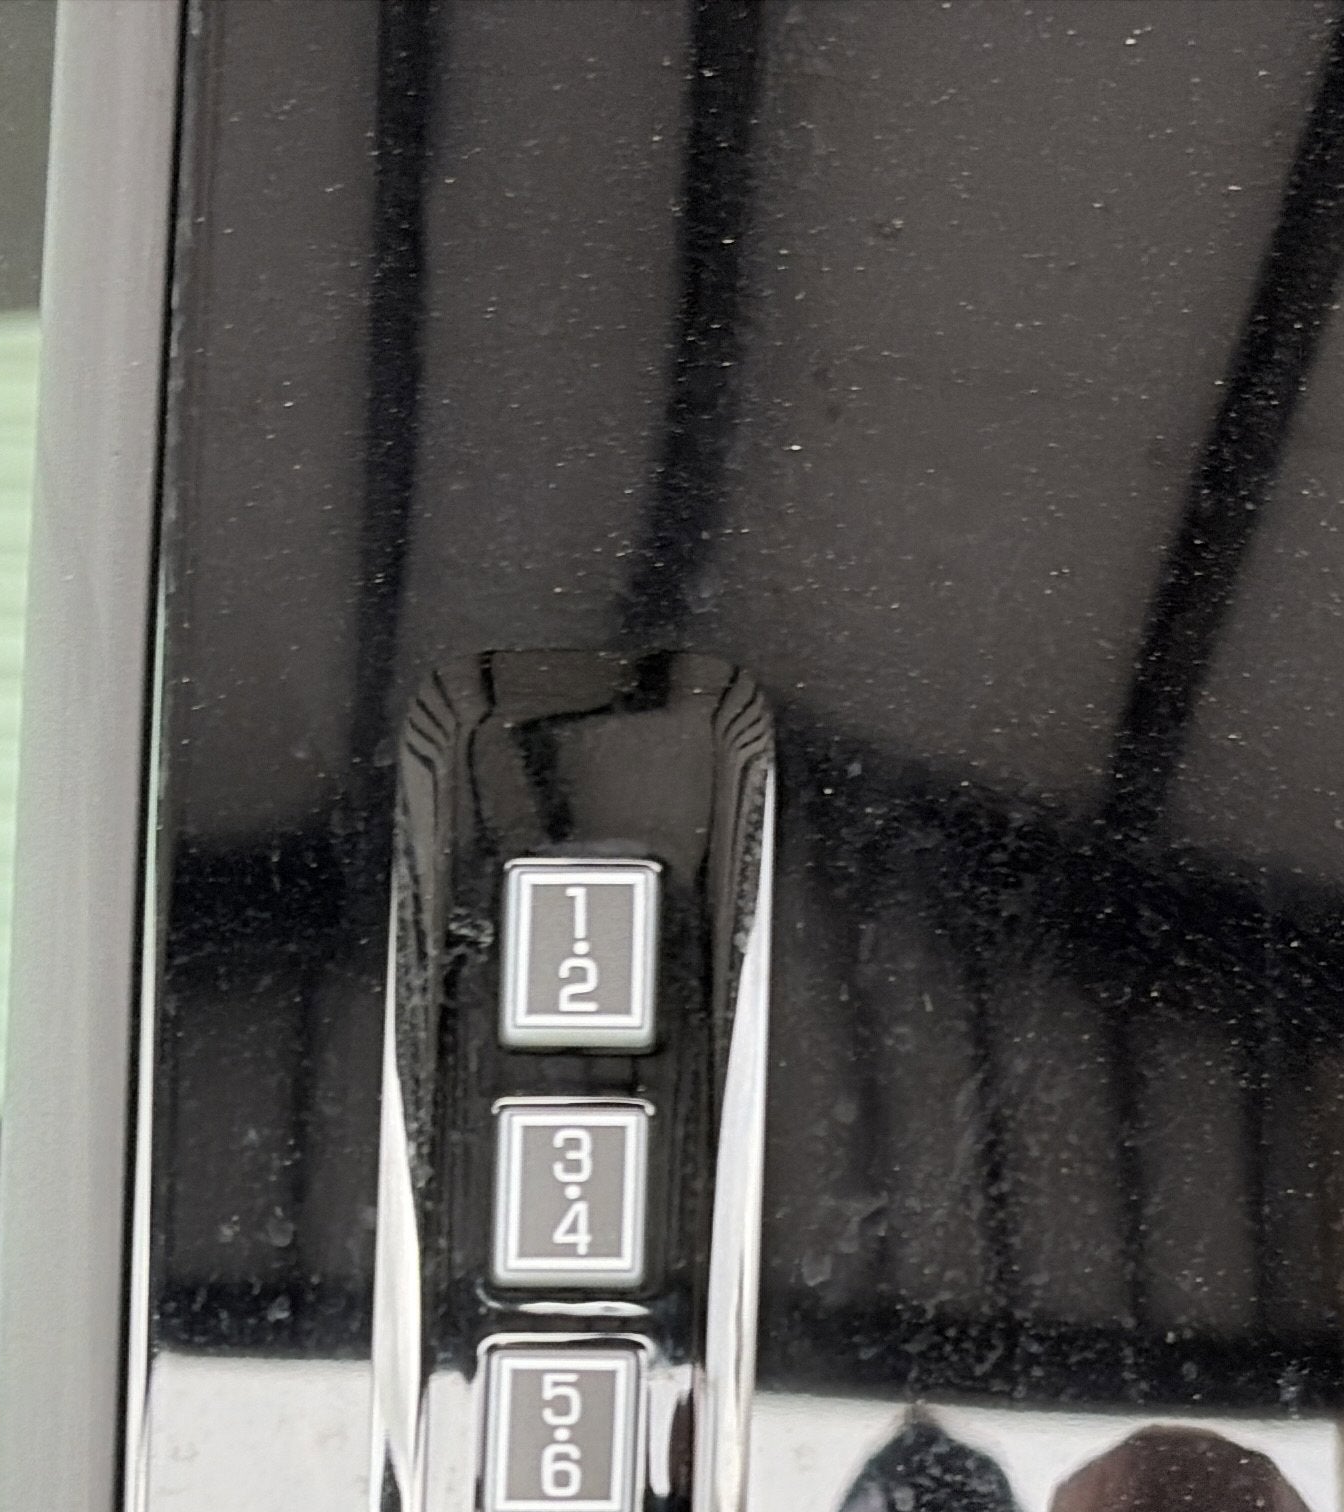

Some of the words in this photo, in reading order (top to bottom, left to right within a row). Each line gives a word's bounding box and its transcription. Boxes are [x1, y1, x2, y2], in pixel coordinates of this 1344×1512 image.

[565, 887, 590, 940] 1
[558, 957, 598, 1013] 2
[552, 1128, 592, 1184] 3
[552, 1201, 592, 1255] 4
[541, 1373, 581, 1426] 5
[541, 1444, 581, 1498] 6
